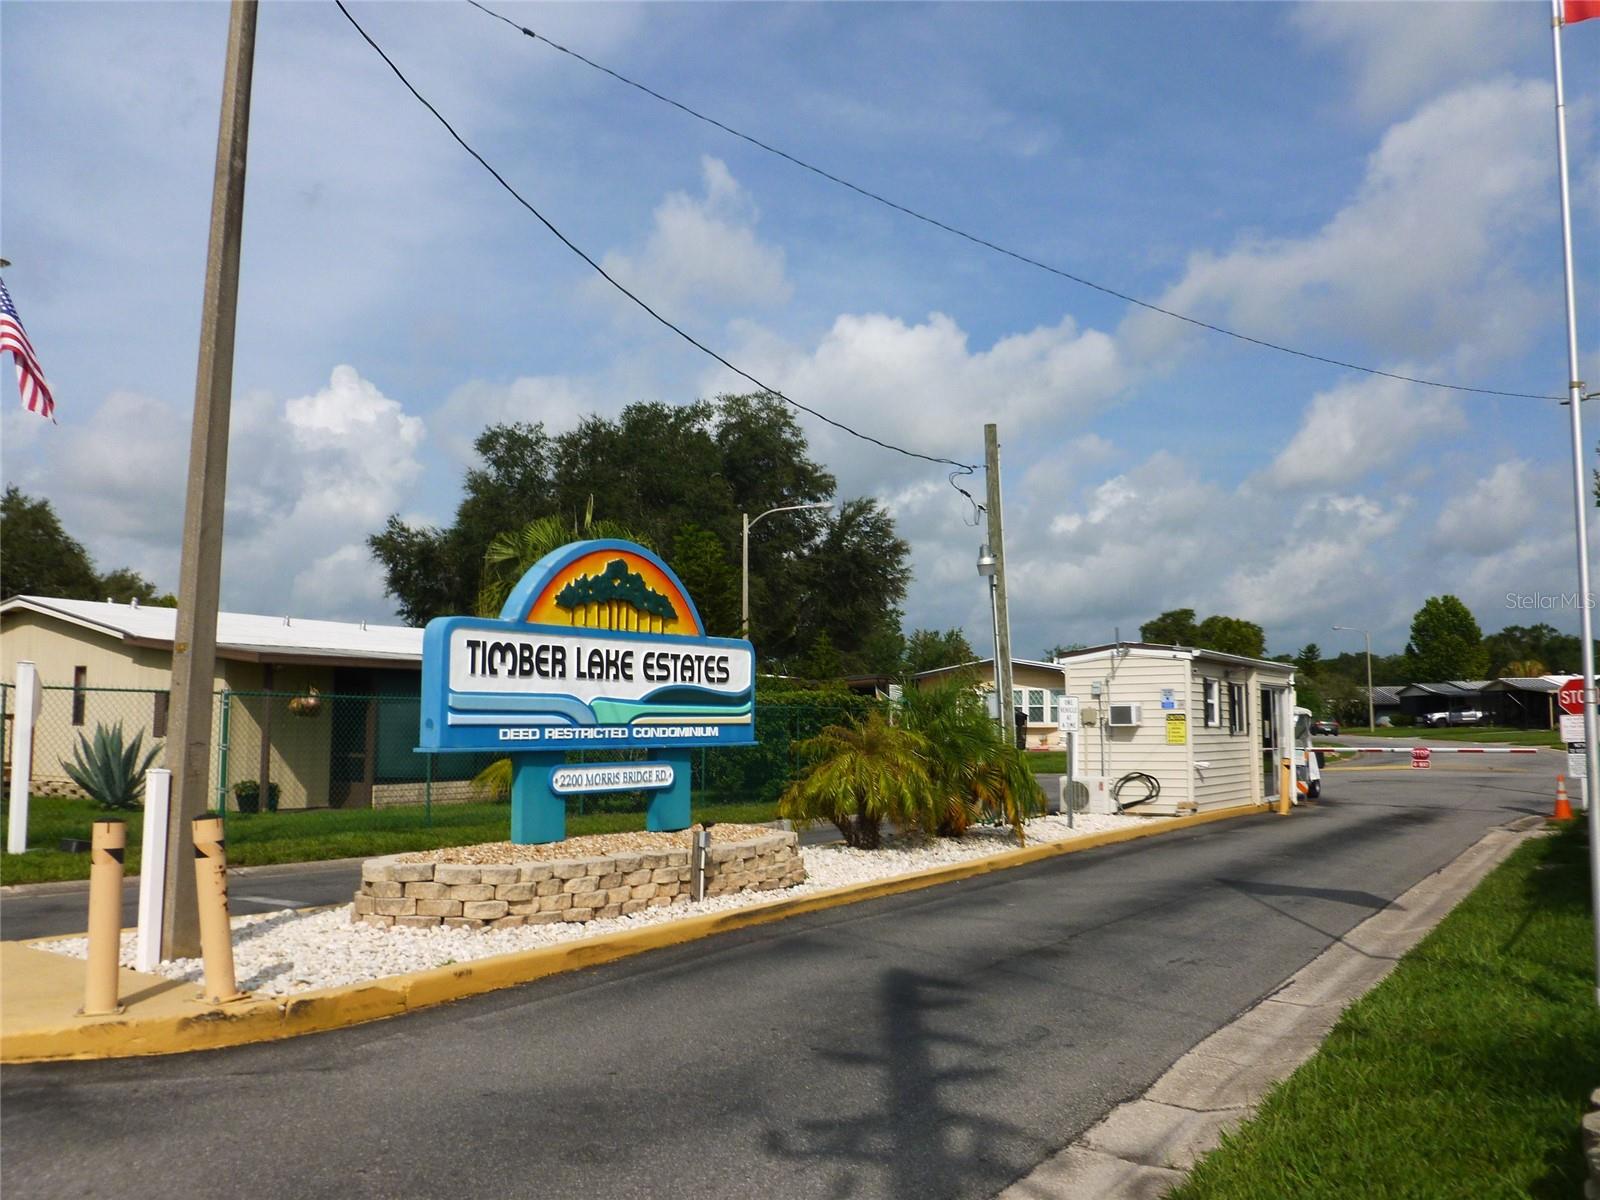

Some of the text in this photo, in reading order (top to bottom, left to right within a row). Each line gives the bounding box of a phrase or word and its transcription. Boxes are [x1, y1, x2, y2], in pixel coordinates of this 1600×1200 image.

[466, 639, 730, 684] TIMBER LAKE ESTATES
[1561, 690, 1585, 704] STO
[499, 726, 719, 740] DEED RESTRICTED CONDOMINIUM
[559, 770, 668, 788] 2200 MORRIS BRIDGE RD.
